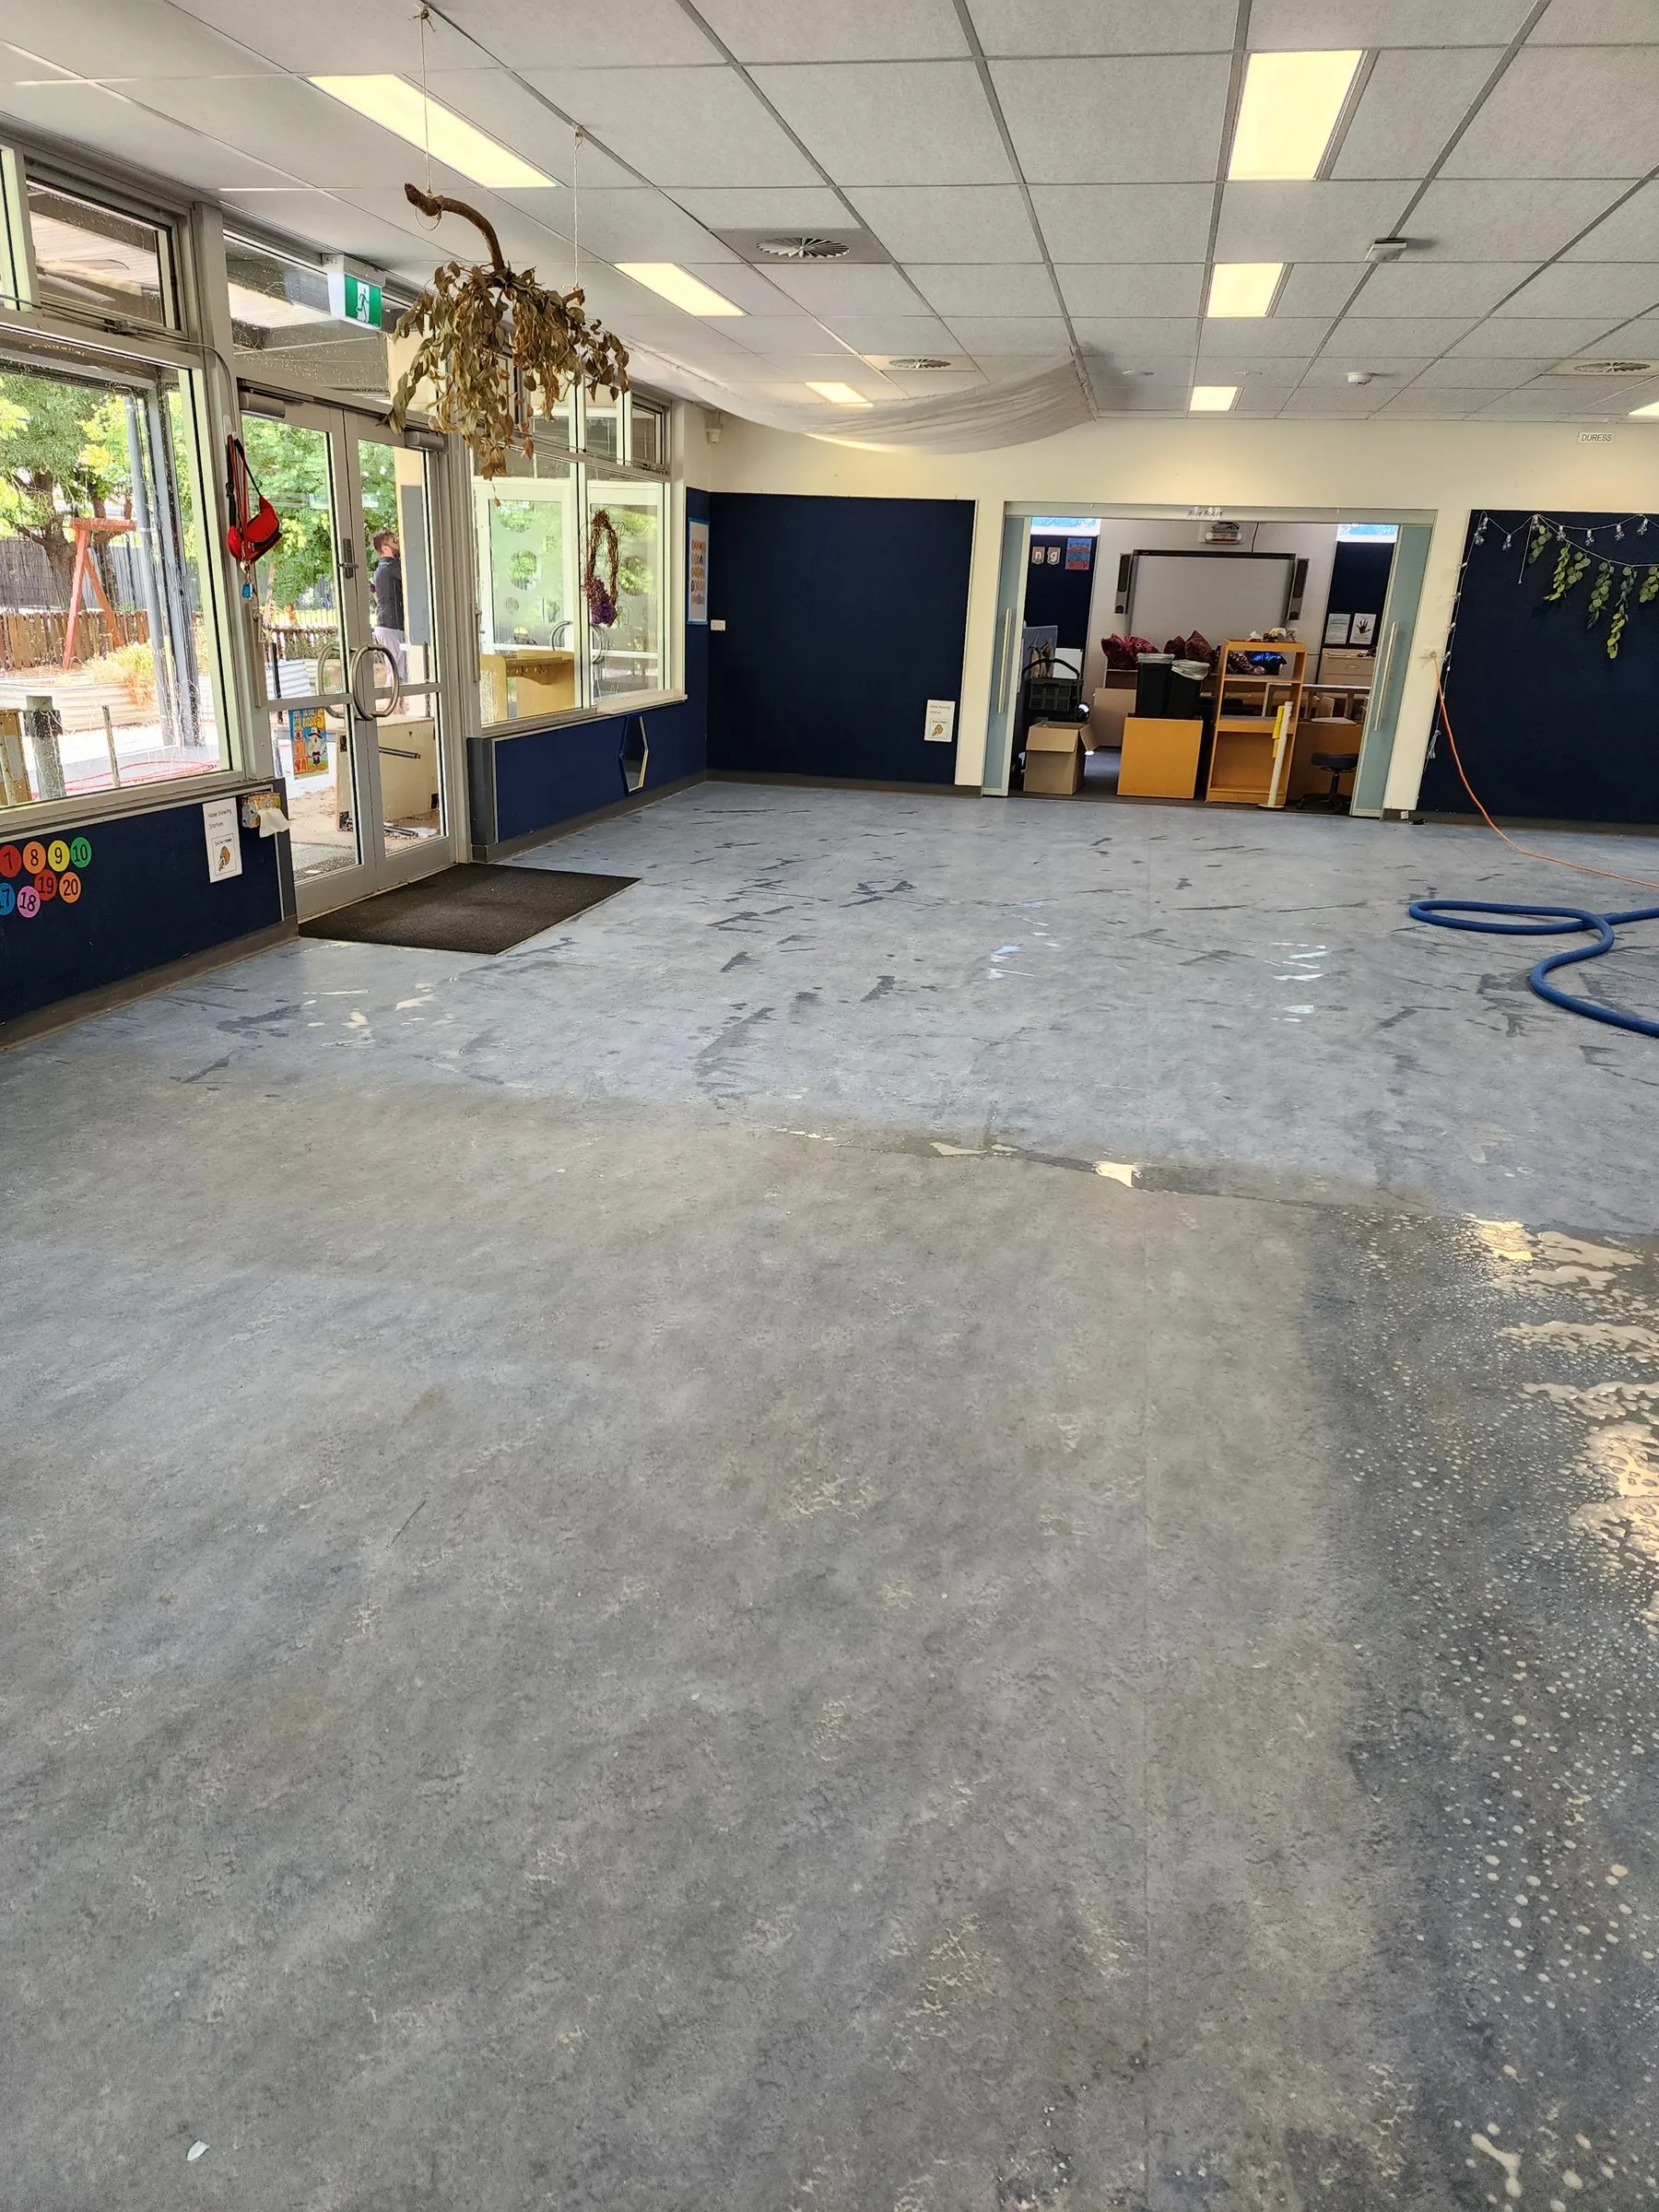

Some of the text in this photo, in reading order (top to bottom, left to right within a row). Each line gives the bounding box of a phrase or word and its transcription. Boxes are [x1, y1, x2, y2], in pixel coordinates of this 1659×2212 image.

[3, 843, 88, 870] 7 8 9 10
[19, 891, 37, 912] 18
[38, 877, 54, 894] 19
[63, 878, 78, 897] 20
